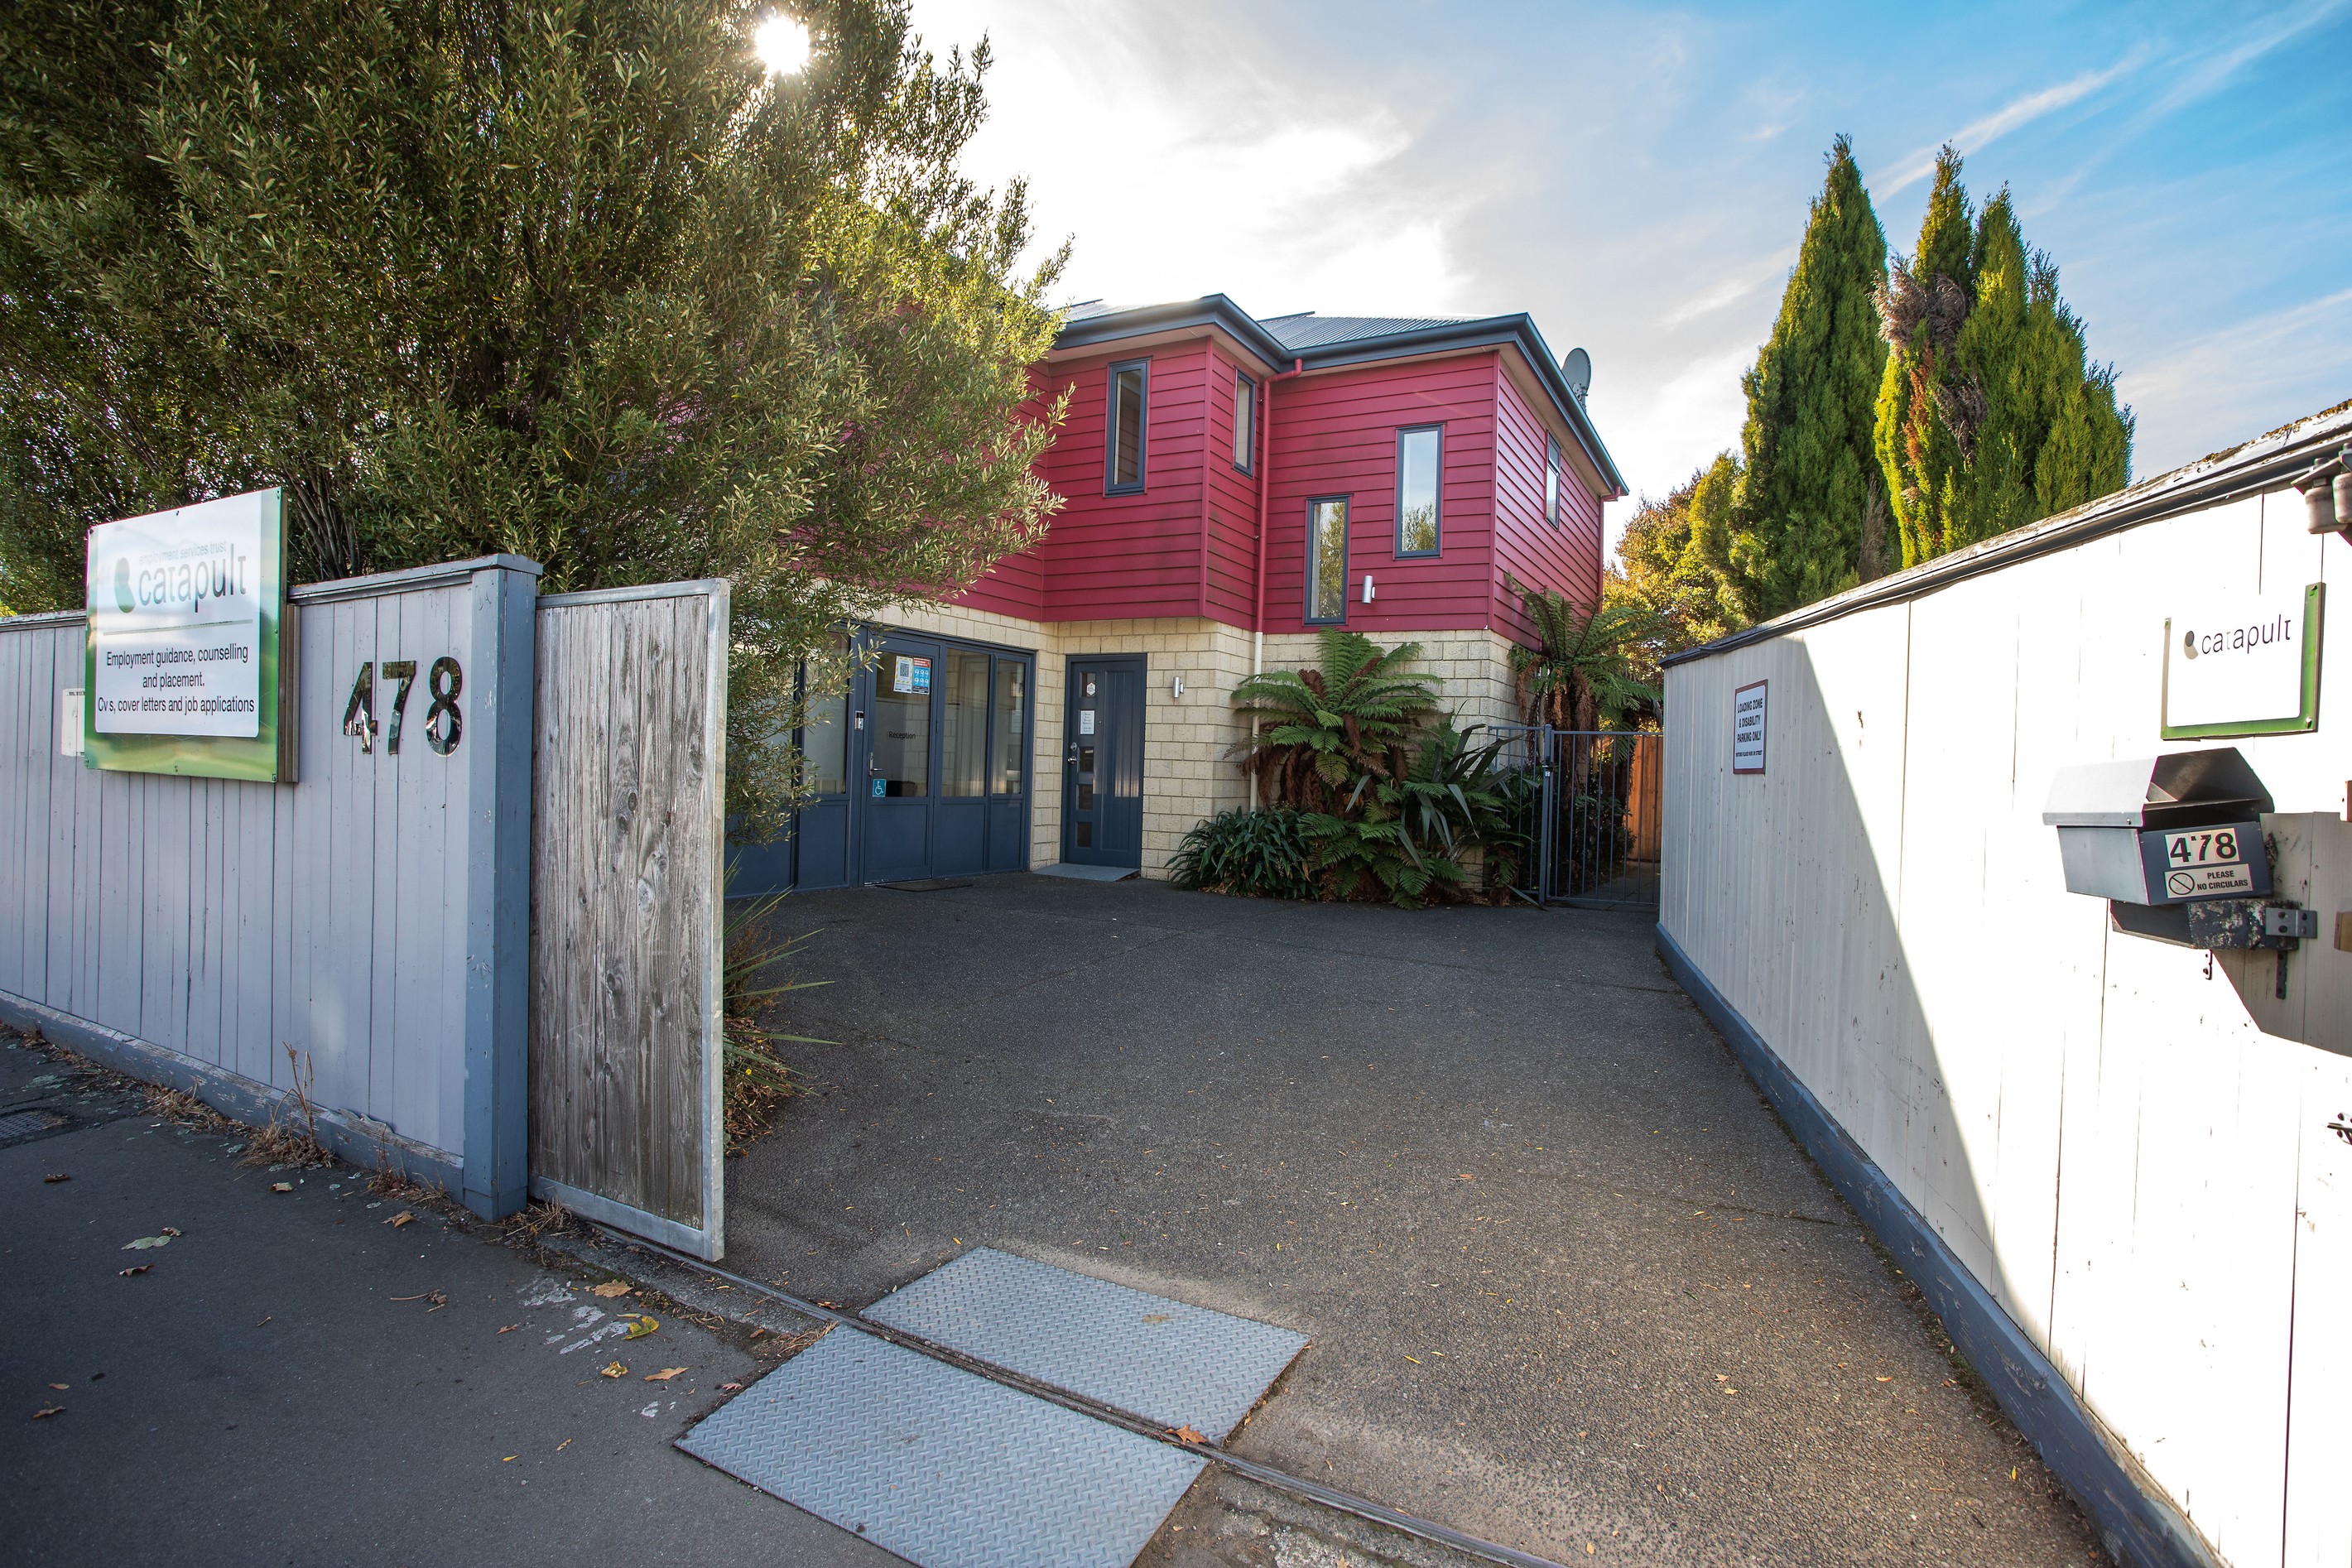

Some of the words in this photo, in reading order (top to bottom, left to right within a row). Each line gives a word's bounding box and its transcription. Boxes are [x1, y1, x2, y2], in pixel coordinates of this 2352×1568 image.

[138, 549, 180, 567] employment
[180, 543, 209, 559] services
[209, 540, 227, 554] trust
[139, 543, 247, 613] catapult
[2201, 613, 2292, 655] catapult
[106, 650, 155, 670] Employment
[156, 647, 196, 668] guidance,
[198, 642, 249, 664] counselling
[142, 672, 158, 689] and
[160, 671, 205, 691] placement.
[118, 700, 140, 712] cover
[141, 696, 166, 712] letters
[167, 696, 183, 713] and
[184, 695, 199, 716] job
[200, 695, 255, 716] applications
[343, 656, 464, 758] 478
[1738, 700, 1752, 713] LOADING
[1753, 698, 1763, 709] ZONE
[1742, 714, 1761, 727] DISABILITY
[888, 730, 916, 741] Reception
[1737, 732, 1752, 743] PARKING
[1753, 730, 1762, 741] ONLY
[2169, 832, 2237, 863] 478
[2206, 870, 2234, 880] PLEASE
[2208, 879, 2249, 890] CIRCULARS
